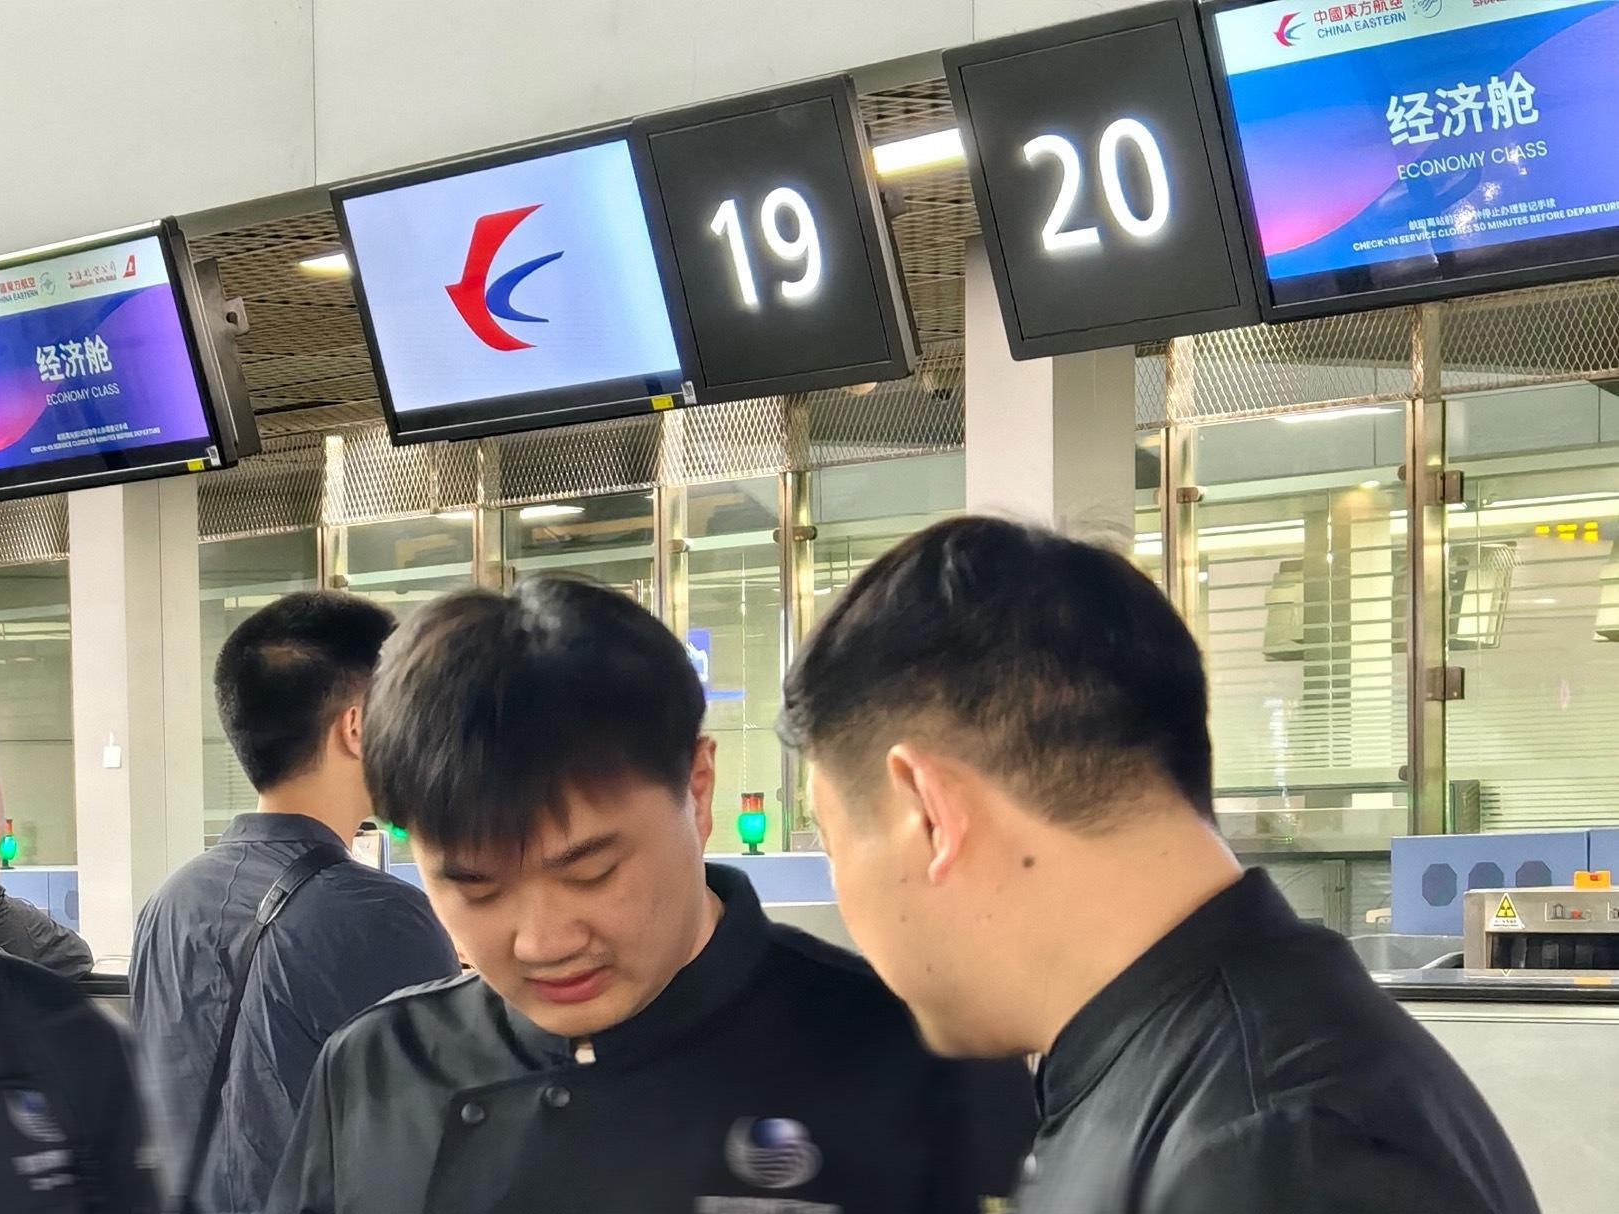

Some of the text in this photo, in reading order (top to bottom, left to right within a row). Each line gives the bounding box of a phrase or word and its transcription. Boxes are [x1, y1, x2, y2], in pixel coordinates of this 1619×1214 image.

[1317, 12, 1407, 38] CHINA EASTERN
[1386, 71, 1539, 146] 经济舱
[1397, 141, 1548, 180] ECONOMY CLASS
[1023, 117, 1171, 252] 20
[710, 187, 823, 306] 19
[1353, 236, 1399, 252] CHECK-IN
[1399, 230, 1437, 244] SERVICE
[1487, 216, 1529, 230] MINUTES
[1530, 209, 1566, 223] BEFORE
[36, 334, 113, 381] 经济舱
[46, 382, 120, 406] ECONOMY CLASS
